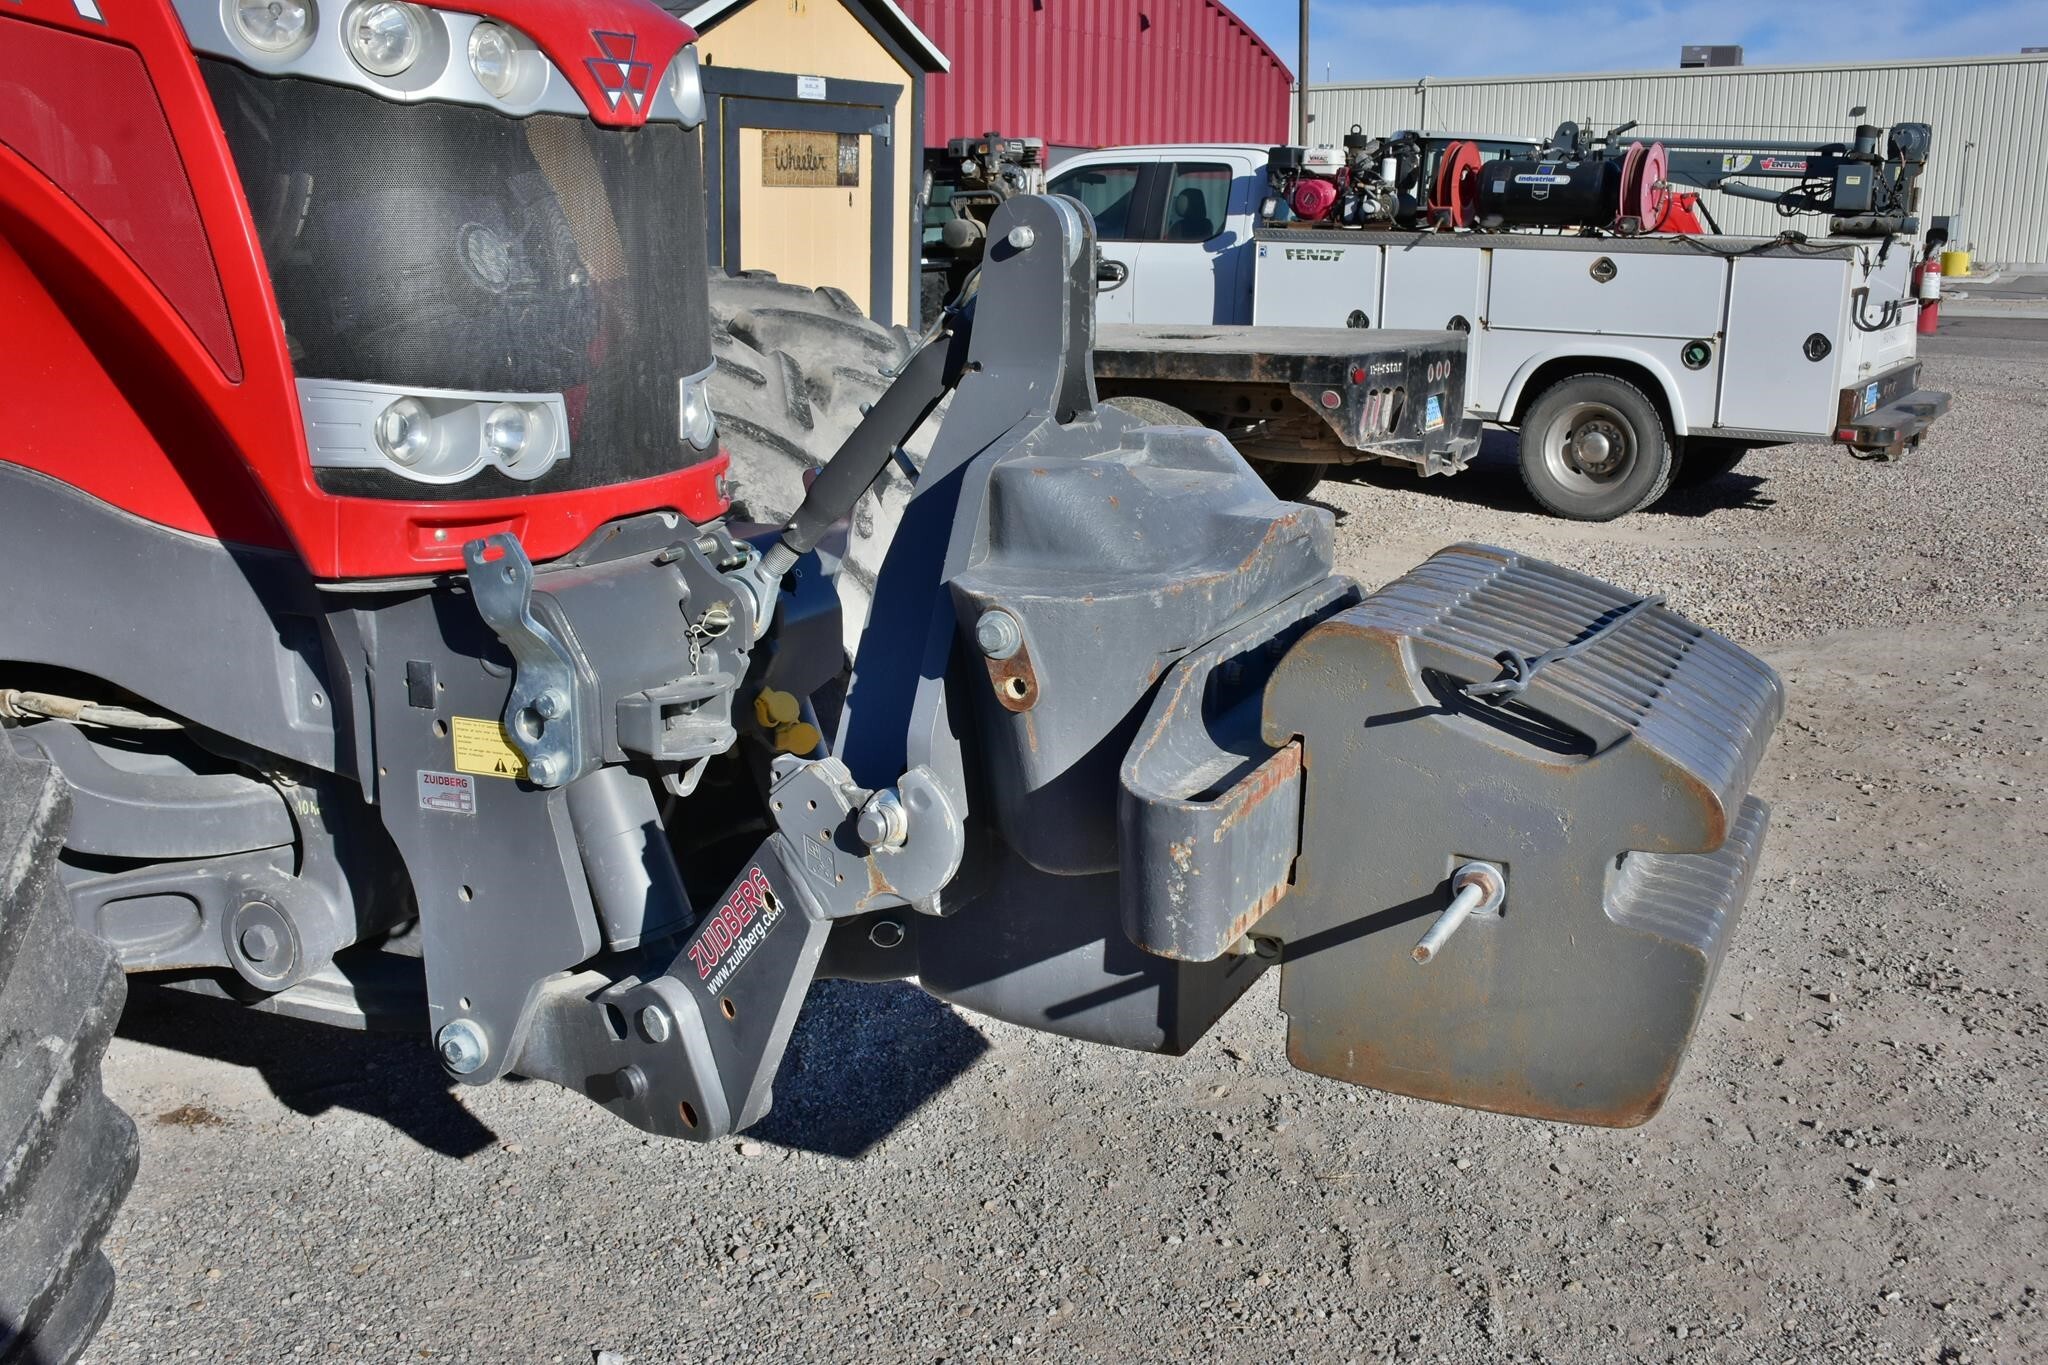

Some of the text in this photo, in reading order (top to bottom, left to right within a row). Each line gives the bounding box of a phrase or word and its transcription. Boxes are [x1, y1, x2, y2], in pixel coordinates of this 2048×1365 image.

[775, 144, 827, 171] Wheeler
[1760, 158, 1808, 169] VENTURO
[1285, 249, 1344, 262] FENDT
[423, 774, 468, 788] ZUIDBERG
[687, 867, 771, 980] ZUIDBERG
